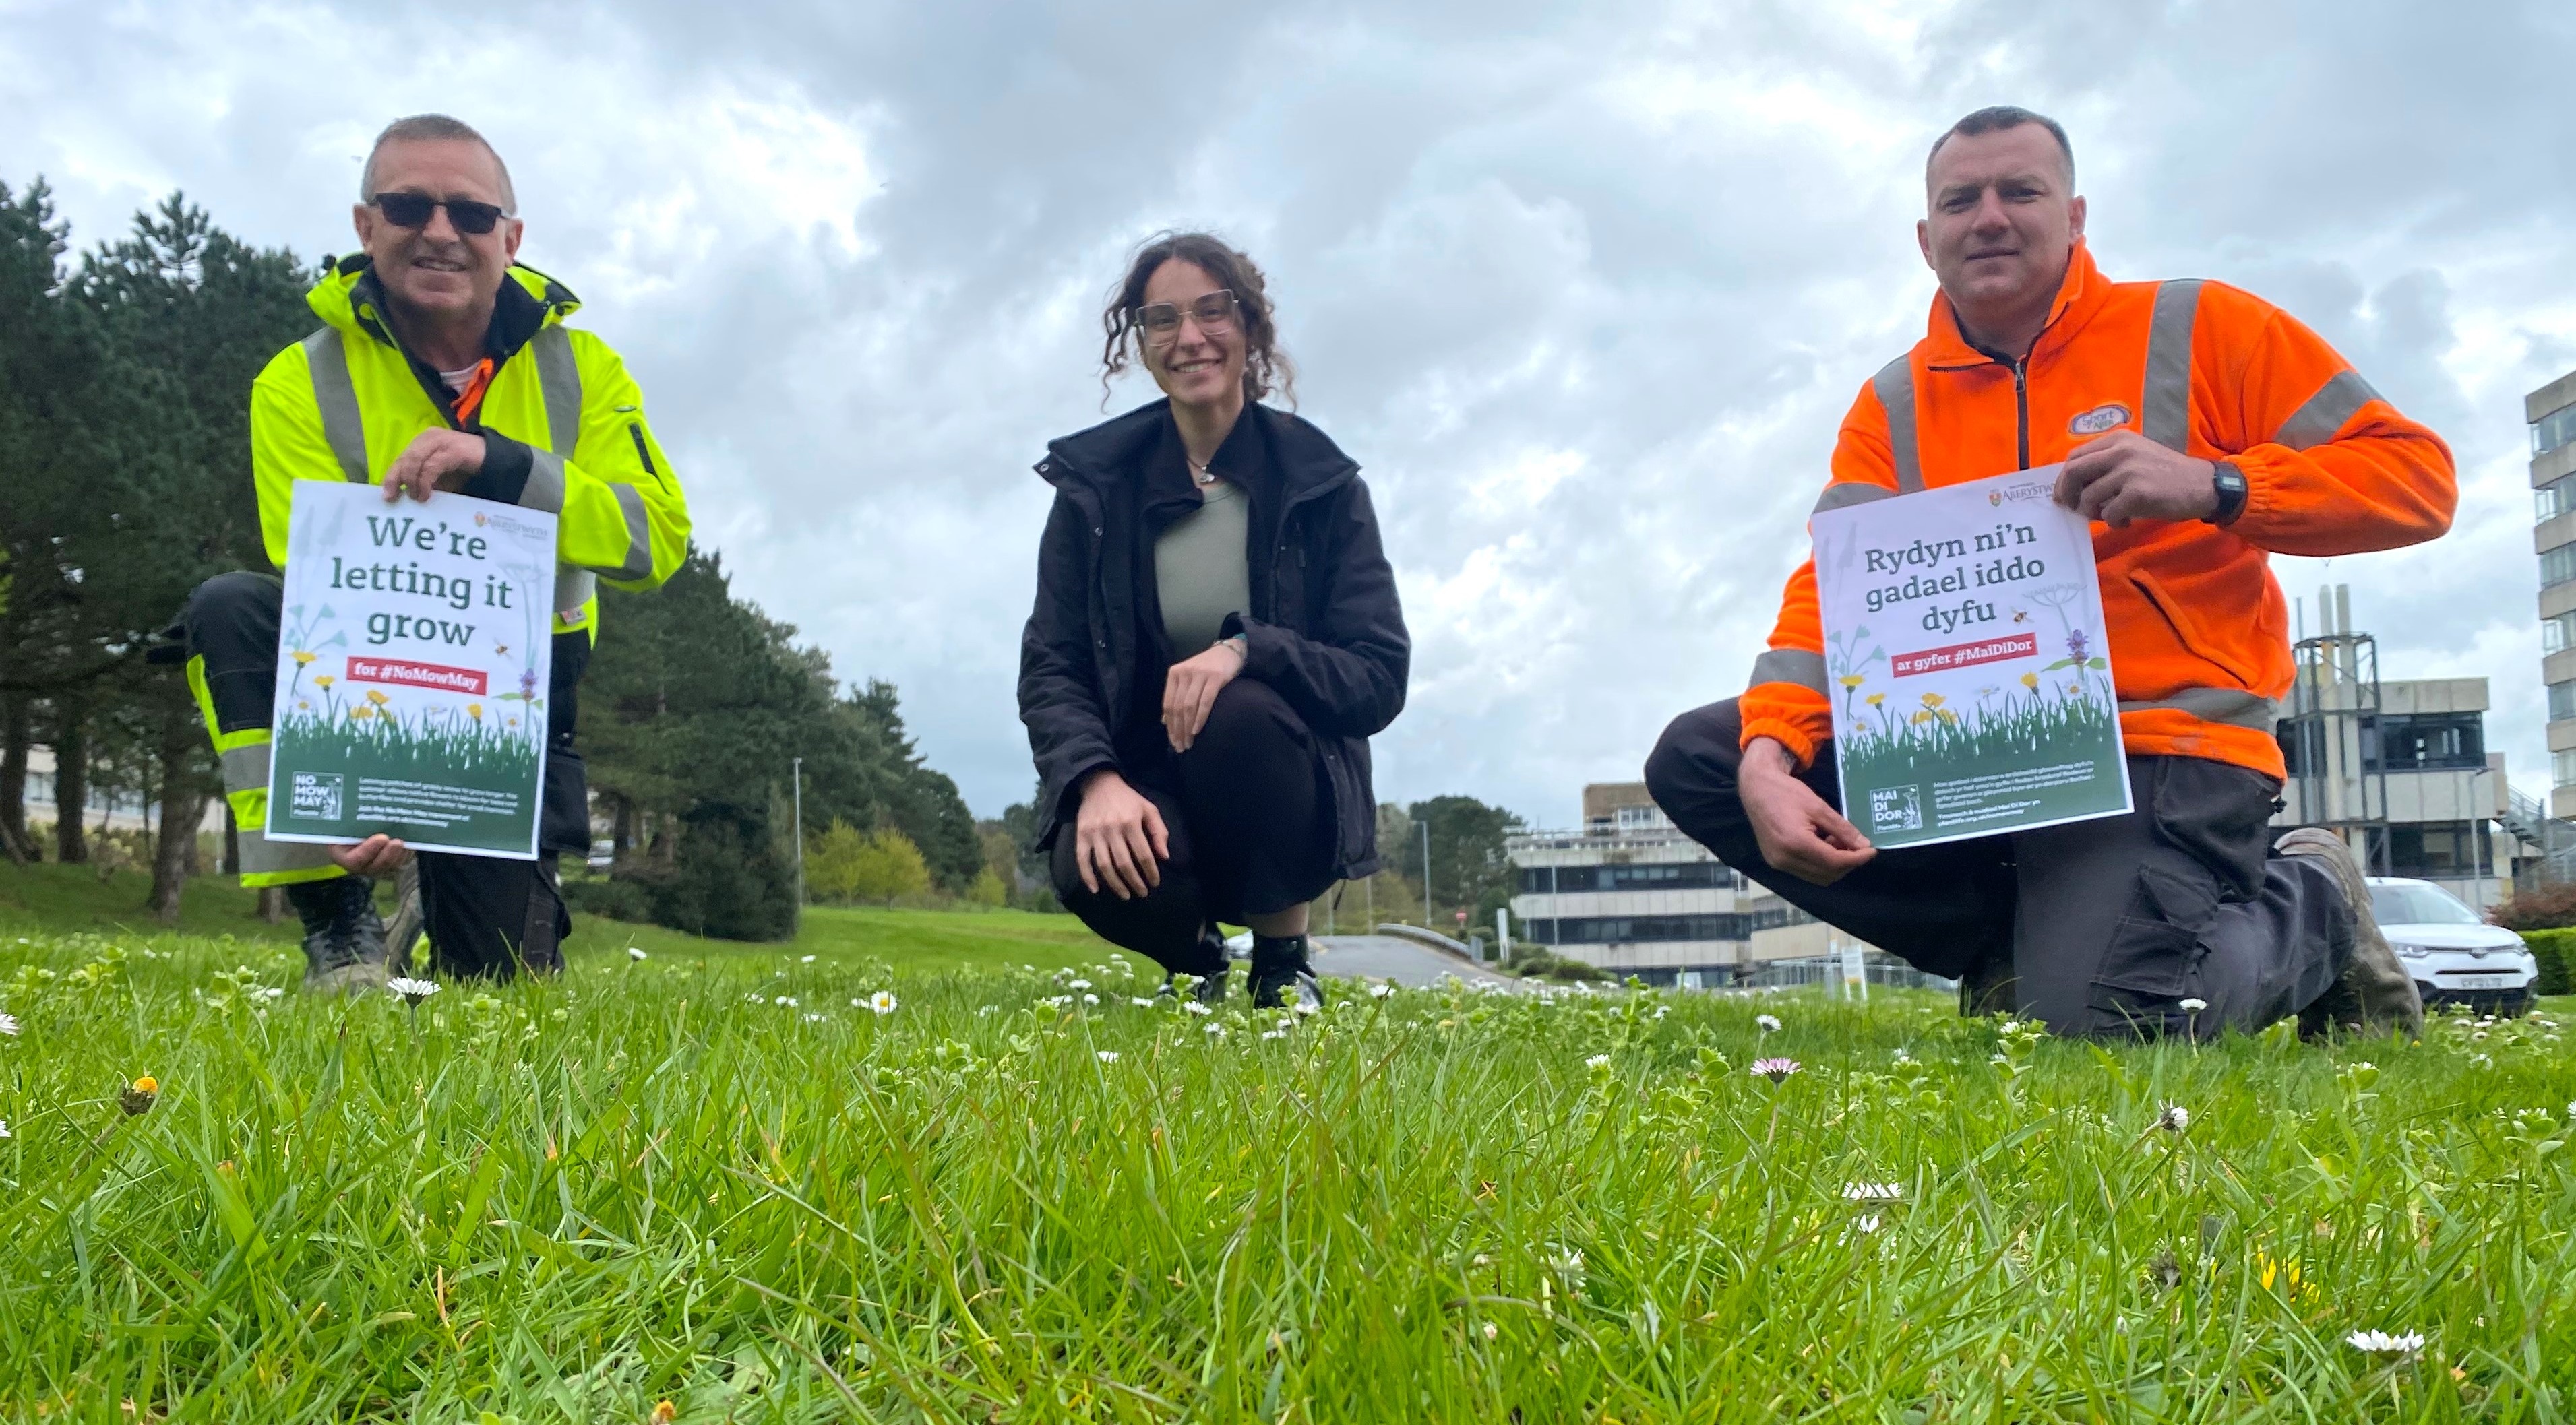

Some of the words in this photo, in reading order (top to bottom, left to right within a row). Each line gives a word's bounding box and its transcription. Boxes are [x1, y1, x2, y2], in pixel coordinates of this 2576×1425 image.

[2002, 483, 2056, 501] ABERYSTW
[367, 515, 487, 560] We’re
[1865, 540, 1965, 575] Rydyn
[1975, 523, 2037, 552] ni’n
[330, 557, 472, 610] letting
[484, 575, 513, 608] it
[1866, 567, 1967, 612] gadael
[1975, 555, 2046, 588] iddo
[367, 612, 475, 646] grow
[1922, 600, 1997, 635] dyfu
[1897, 661, 1911, 671] ar
[1914, 654, 1951, 671] gyfer
[1955, 640, 2032, 664] #MaiDiDor
[354, 662, 377, 676] for
[380, 664, 479, 691] #NoMowMay
[295, 775, 317, 786] NO
[295, 785, 330, 796] MOW
[293, 796, 324, 807] MAY
[1873, 790, 1897, 802] MAI
[1874, 801, 1888, 811] DI
[1875, 809, 1903, 822] DOR
